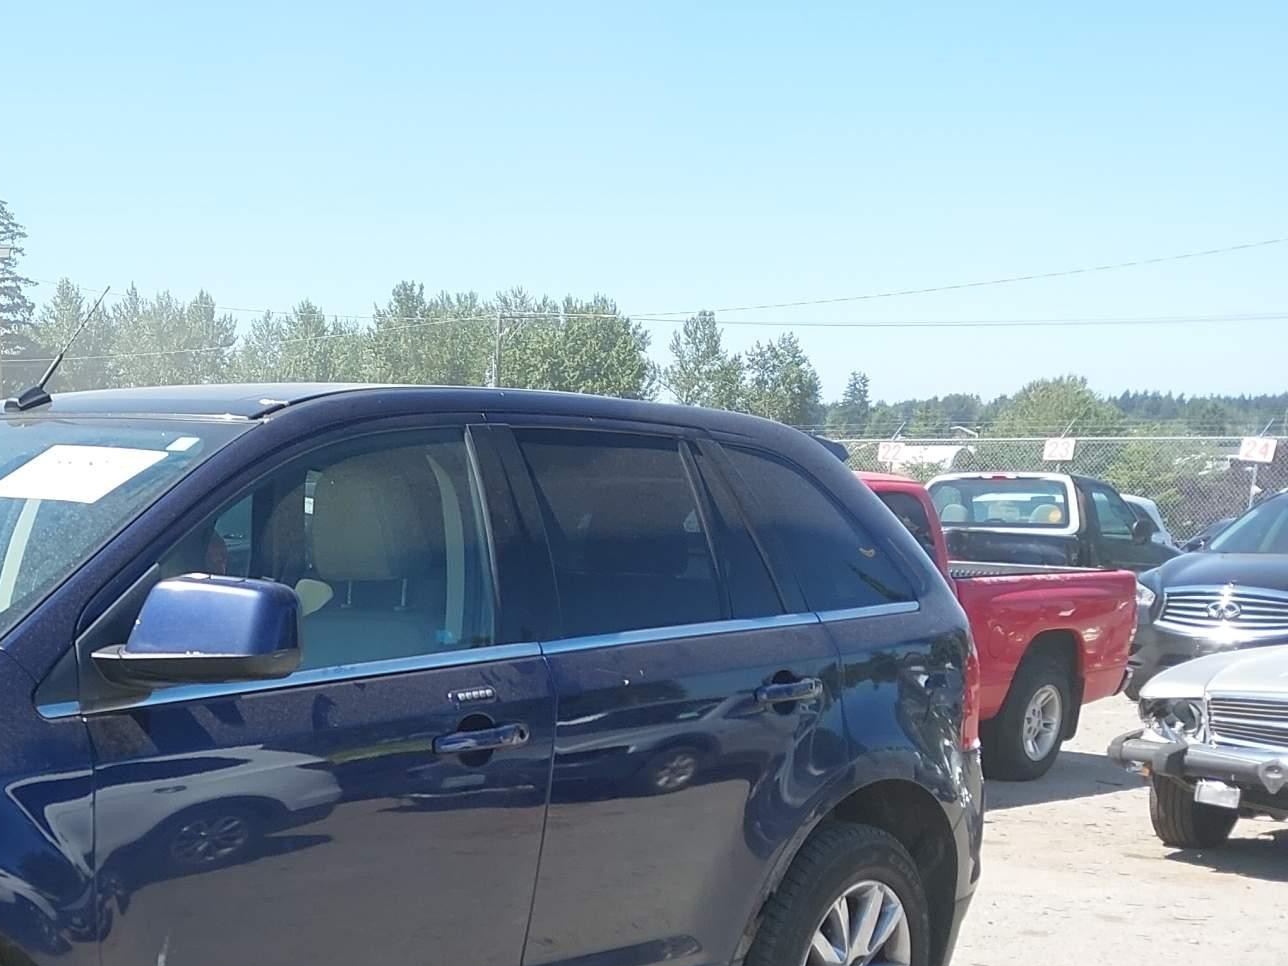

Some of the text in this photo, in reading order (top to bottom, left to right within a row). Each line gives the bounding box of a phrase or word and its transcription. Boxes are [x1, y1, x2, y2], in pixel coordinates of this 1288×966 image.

[881, 443, 902, 461] 22
[1047, 441, 1071, 459] 23
[1243, 440, 1270, 460] 24
